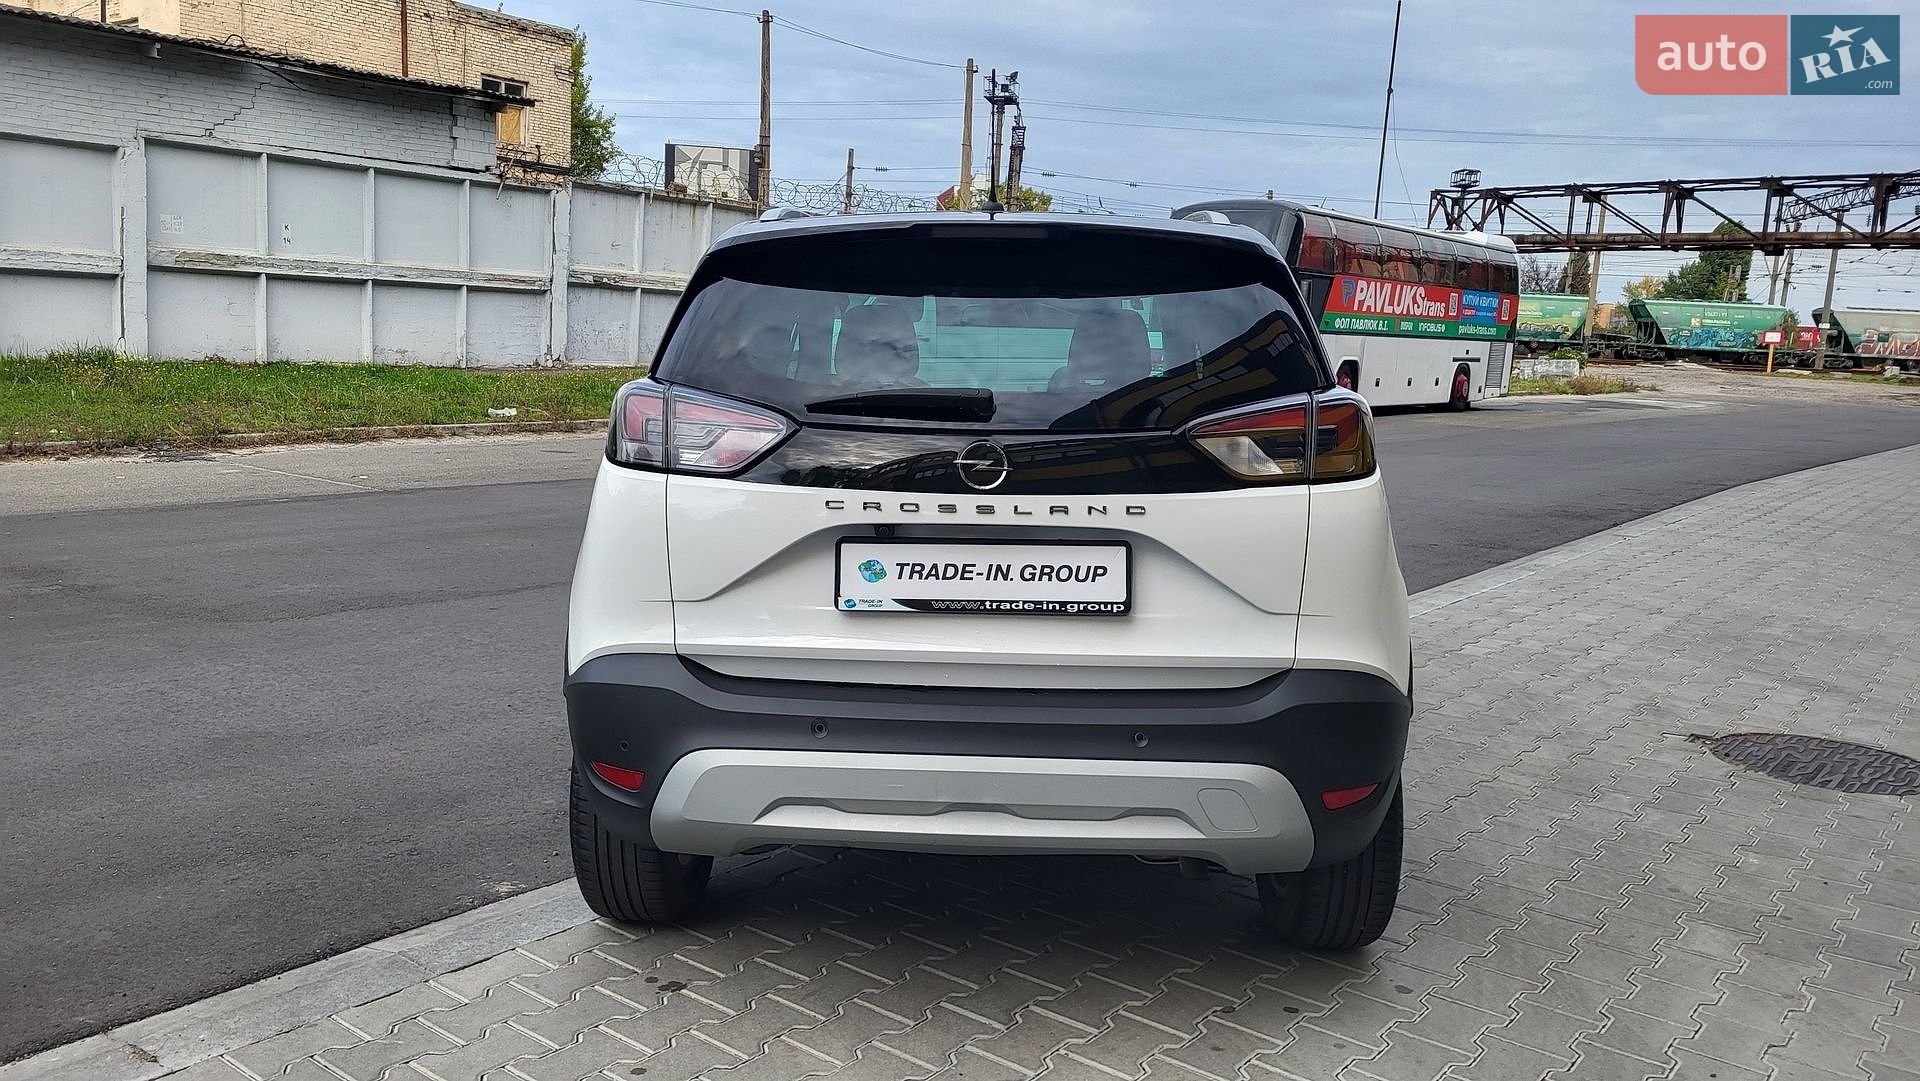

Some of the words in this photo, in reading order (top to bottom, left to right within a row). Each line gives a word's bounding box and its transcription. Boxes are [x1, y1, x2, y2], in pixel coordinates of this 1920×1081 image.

[825, 499, 1146, 516] CROSSLAND
[1019, 564, 1108, 583] GROUP
[931, 600, 1125, 613] www.trade-in.group
